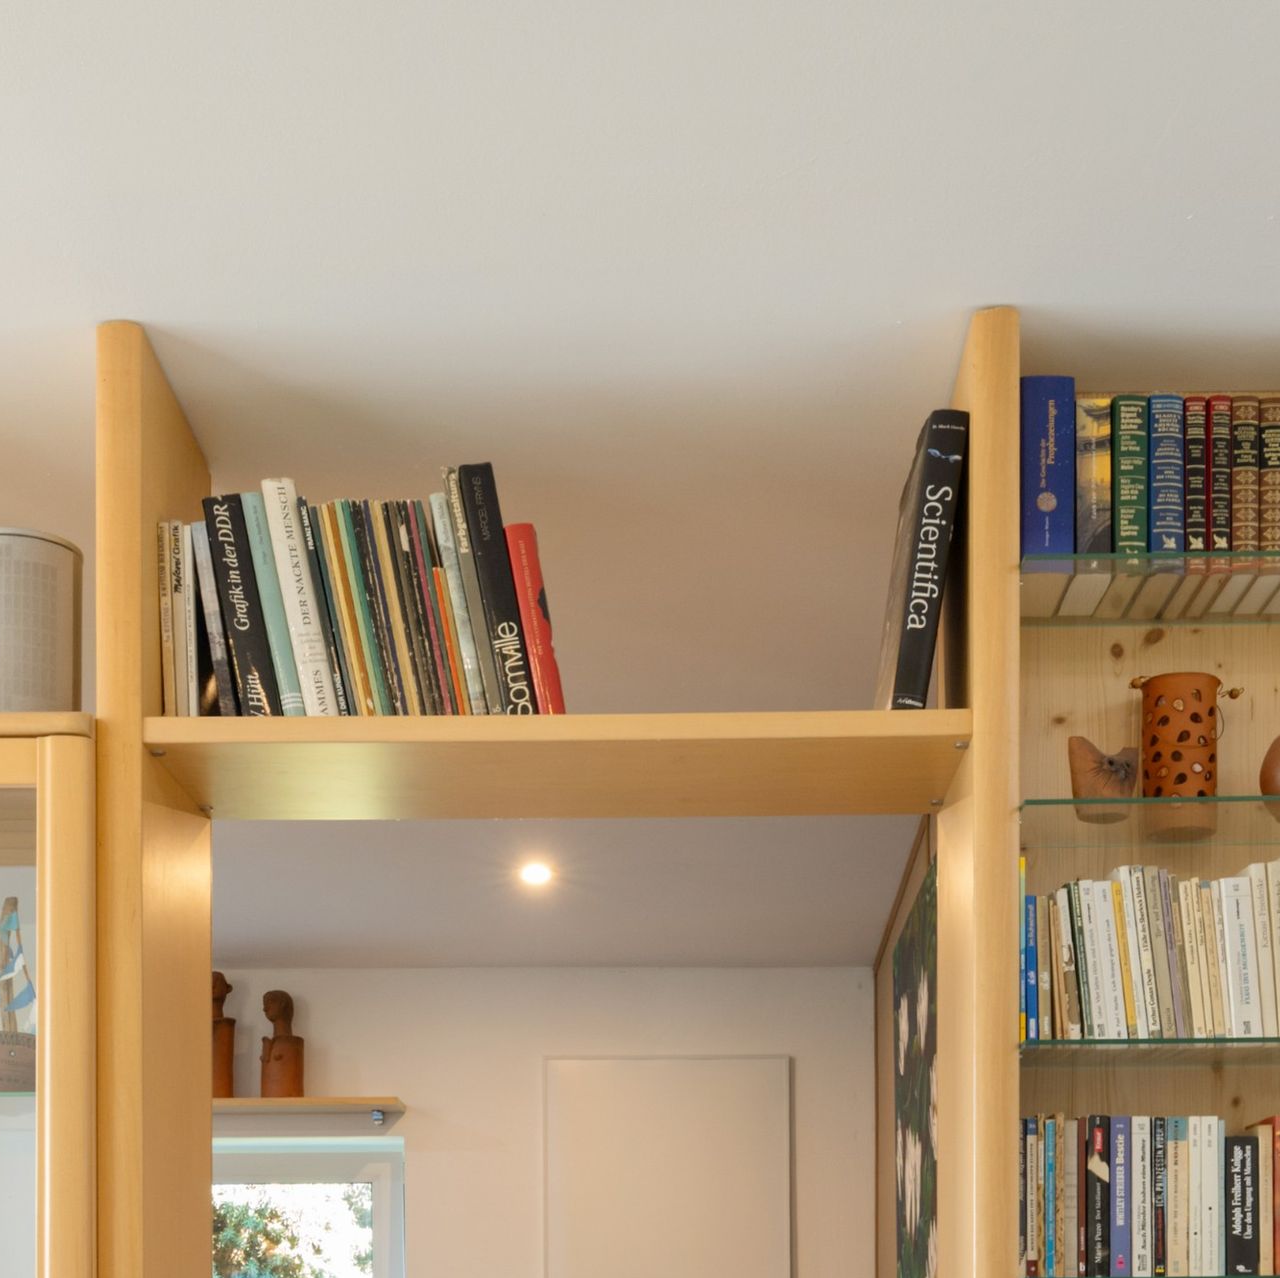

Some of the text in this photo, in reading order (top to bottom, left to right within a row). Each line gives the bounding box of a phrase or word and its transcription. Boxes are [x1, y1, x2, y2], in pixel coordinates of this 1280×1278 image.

[276, 485, 295, 540] MENSCH
[299, 505, 310, 526] MARC
[449, 473, 469, 554] Farbgestaltung
[172, 524, 181, 556] Grafik
[304, 526, 316, 550] FRANZ
[213, 504, 250, 630] Grafik in der DDR
[288, 543, 307, 595] NACKTE
[906, 484, 953, 630] Scientifica
[299, 599, 312, 626] DER
[477, 508, 533, 715] Somville MARCEL
[1134, 876, 1142, 899] Holmes
[1136, 899, 1146, 923] Sherlock
[1145, 968, 1158, 1027] Arthur Conan Doyle
[1115, 1134, 1125, 1165] Bestie
[1243, 1144, 1252, 1176] Menschen
[1231, 1145, 1243, 1236] Adolph Freiherr Knigge
[1244, 1175, 1252, 1187] mit
[1244, 1186, 1254, 1212] Umgang
[1094, 1222, 1102, 1241] Puzo
[1243, 1224, 1252, 1240] Über
[1095, 1241, 1103, 1263] Mario
